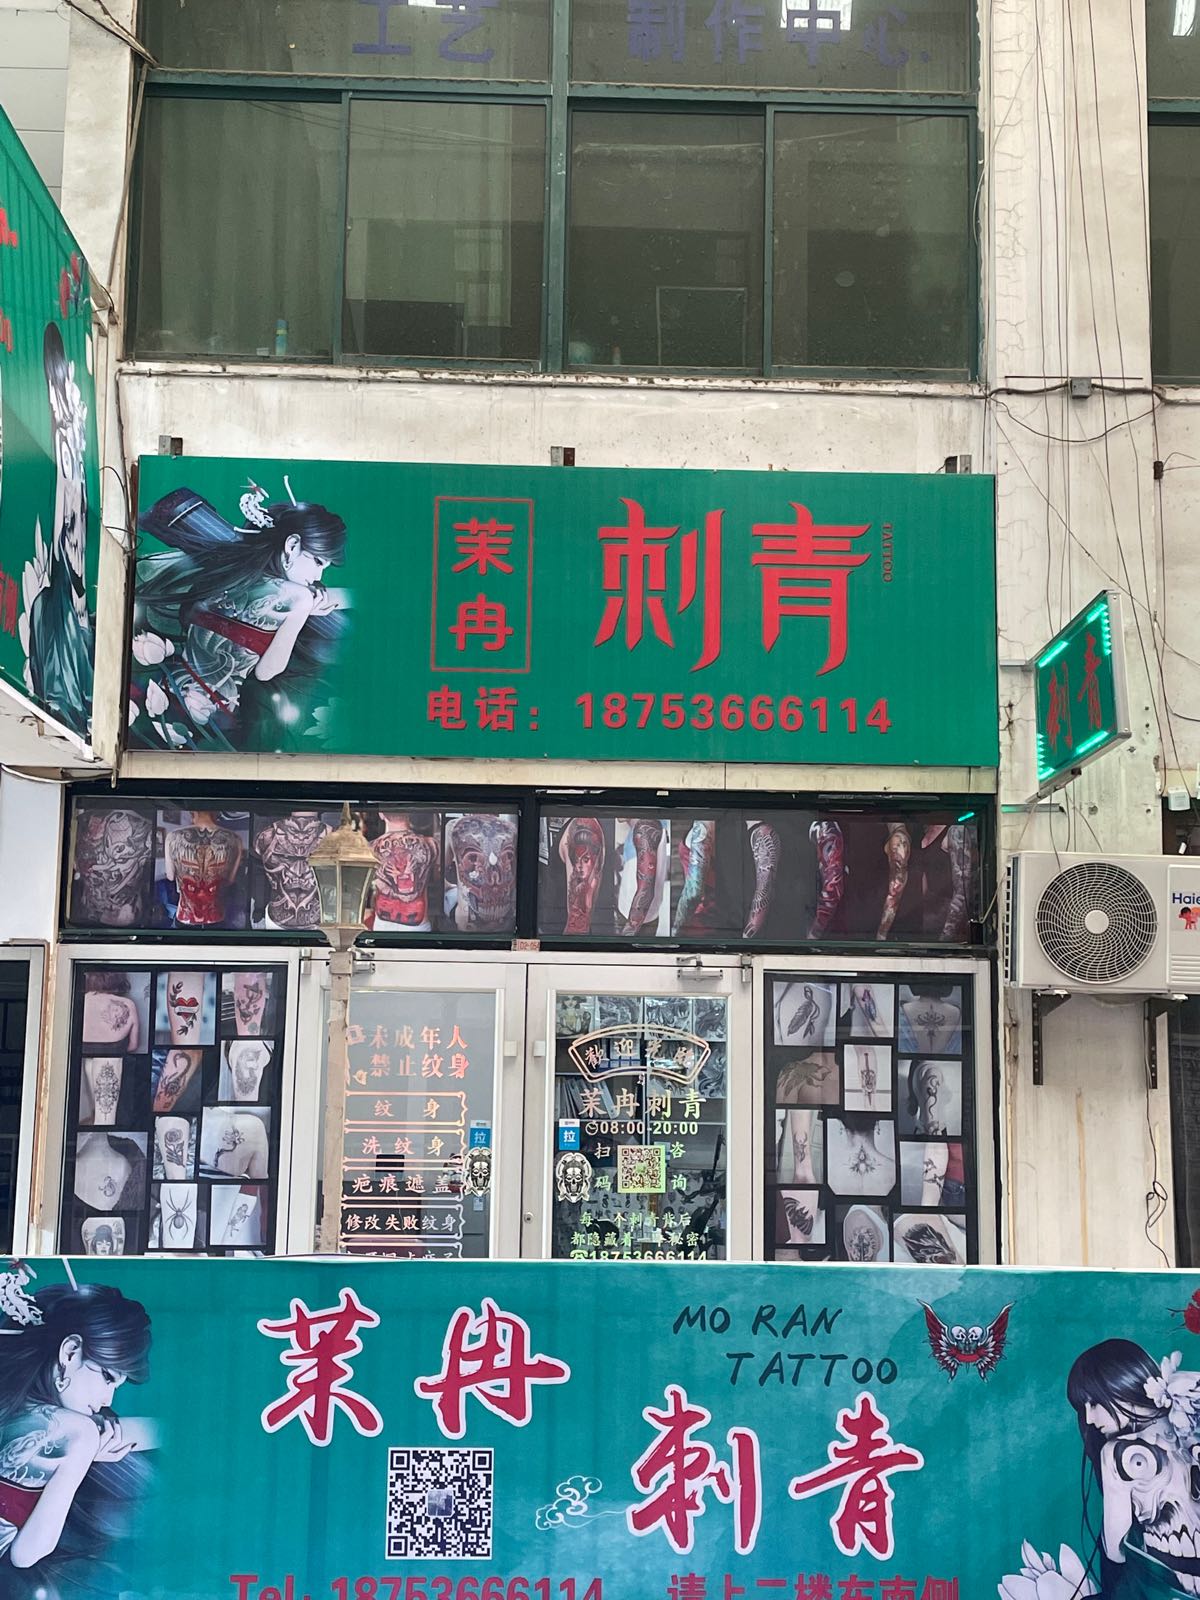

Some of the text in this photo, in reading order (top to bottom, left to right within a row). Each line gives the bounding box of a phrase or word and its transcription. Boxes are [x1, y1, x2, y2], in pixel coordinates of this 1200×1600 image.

[449, 516, 515, 651] 茉冉
[594, 497, 872, 677] 刺青
[576, 691, 893, 735] 18753666114
[368, 1024, 468, 1050] 未成年人
[369, 1053, 470, 1079] 禁止纹身
[374, 1098, 441, 1119] 纹身
[578, 1087, 707, 1120] 茉冉刺青
[362, 1136, 445, 1158] 洗纹身
[474, 1131, 487, 1144] 拉
[563, 1130, 576, 1143] 拉
[352, 1173, 453, 1195] 疤痕遮盖
[345, 1213, 457, 1232] 修改失败纹身
[672, 1303, 844, 1339] MO RAN
[257, 1287, 571, 1447] 茉冉
[726, 1351, 899, 1387] TATTOO
[626, 1384, 925, 1561] 刺青
[229, 1574, 603, 1600] Tel 18753666114
